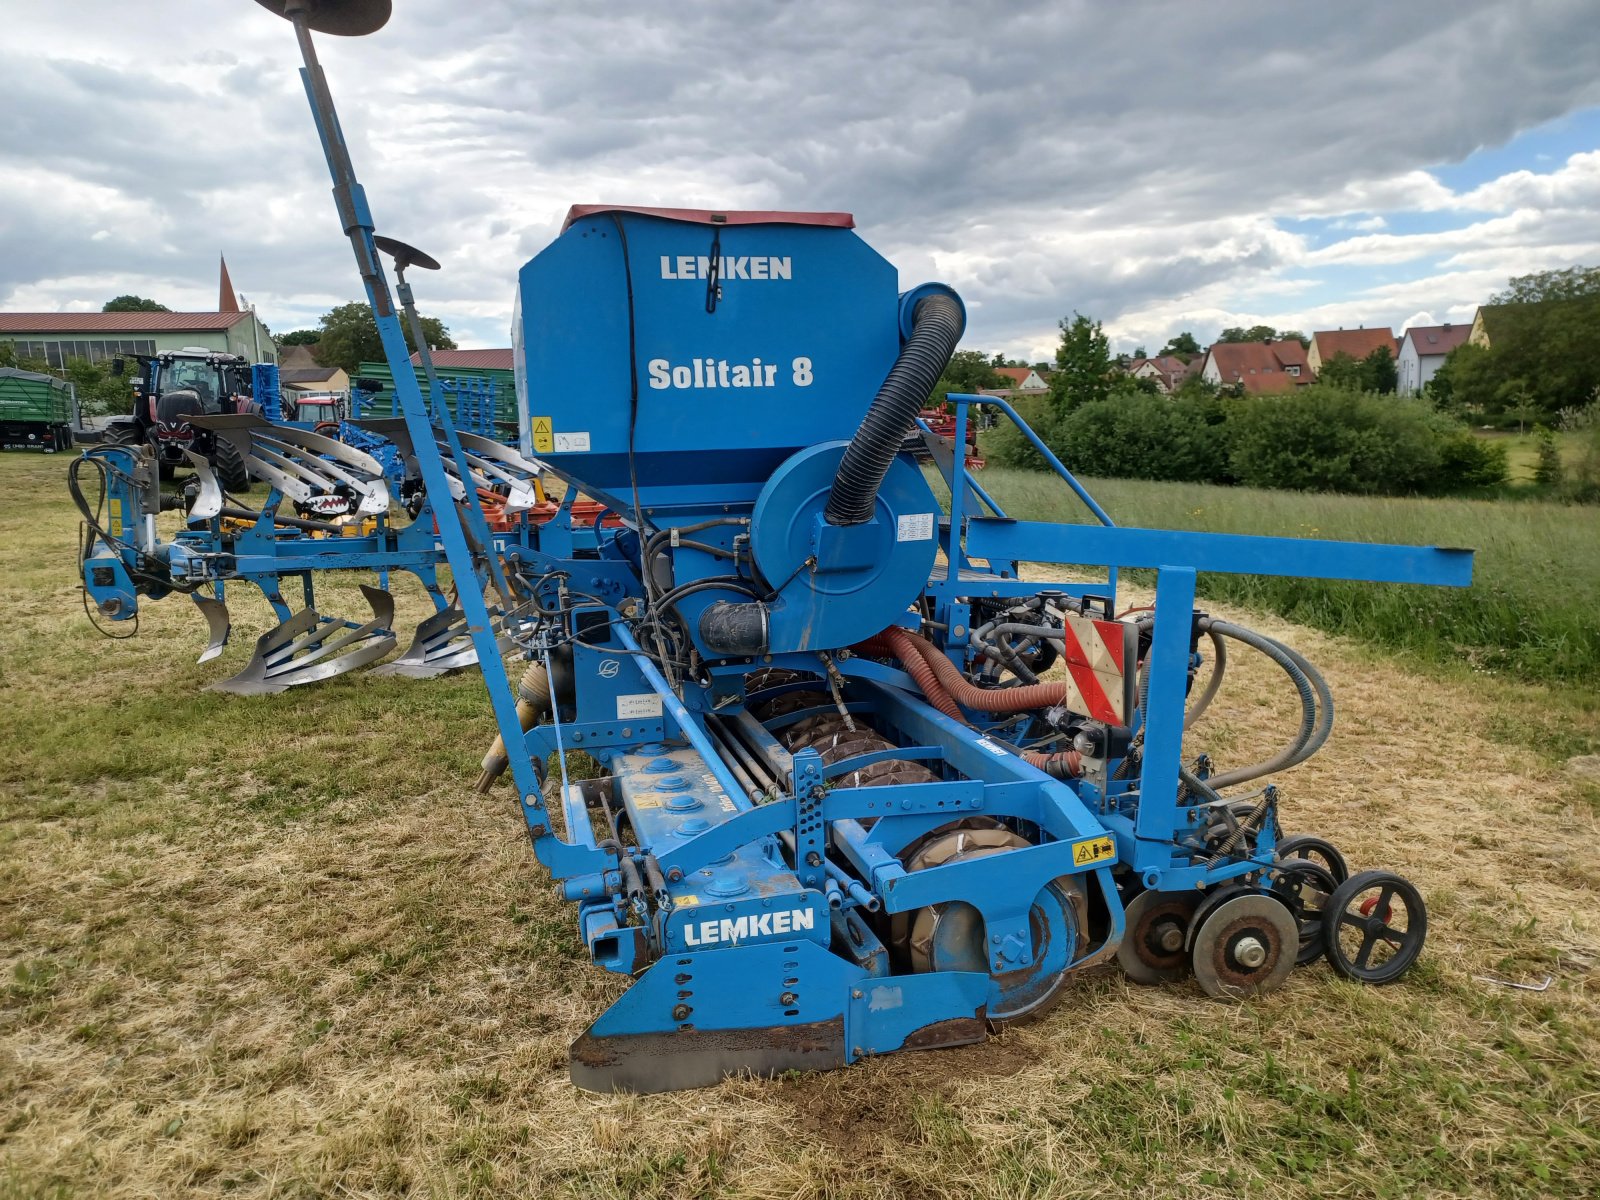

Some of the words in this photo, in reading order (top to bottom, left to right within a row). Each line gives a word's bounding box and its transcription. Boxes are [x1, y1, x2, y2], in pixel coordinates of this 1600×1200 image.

[660, 255, 792, 280] LEMKEN
[648, 357, 777, 389] Solitair
[792, 356, 814, 386] 8
[684, 907, 814, 946] LEMKEN
